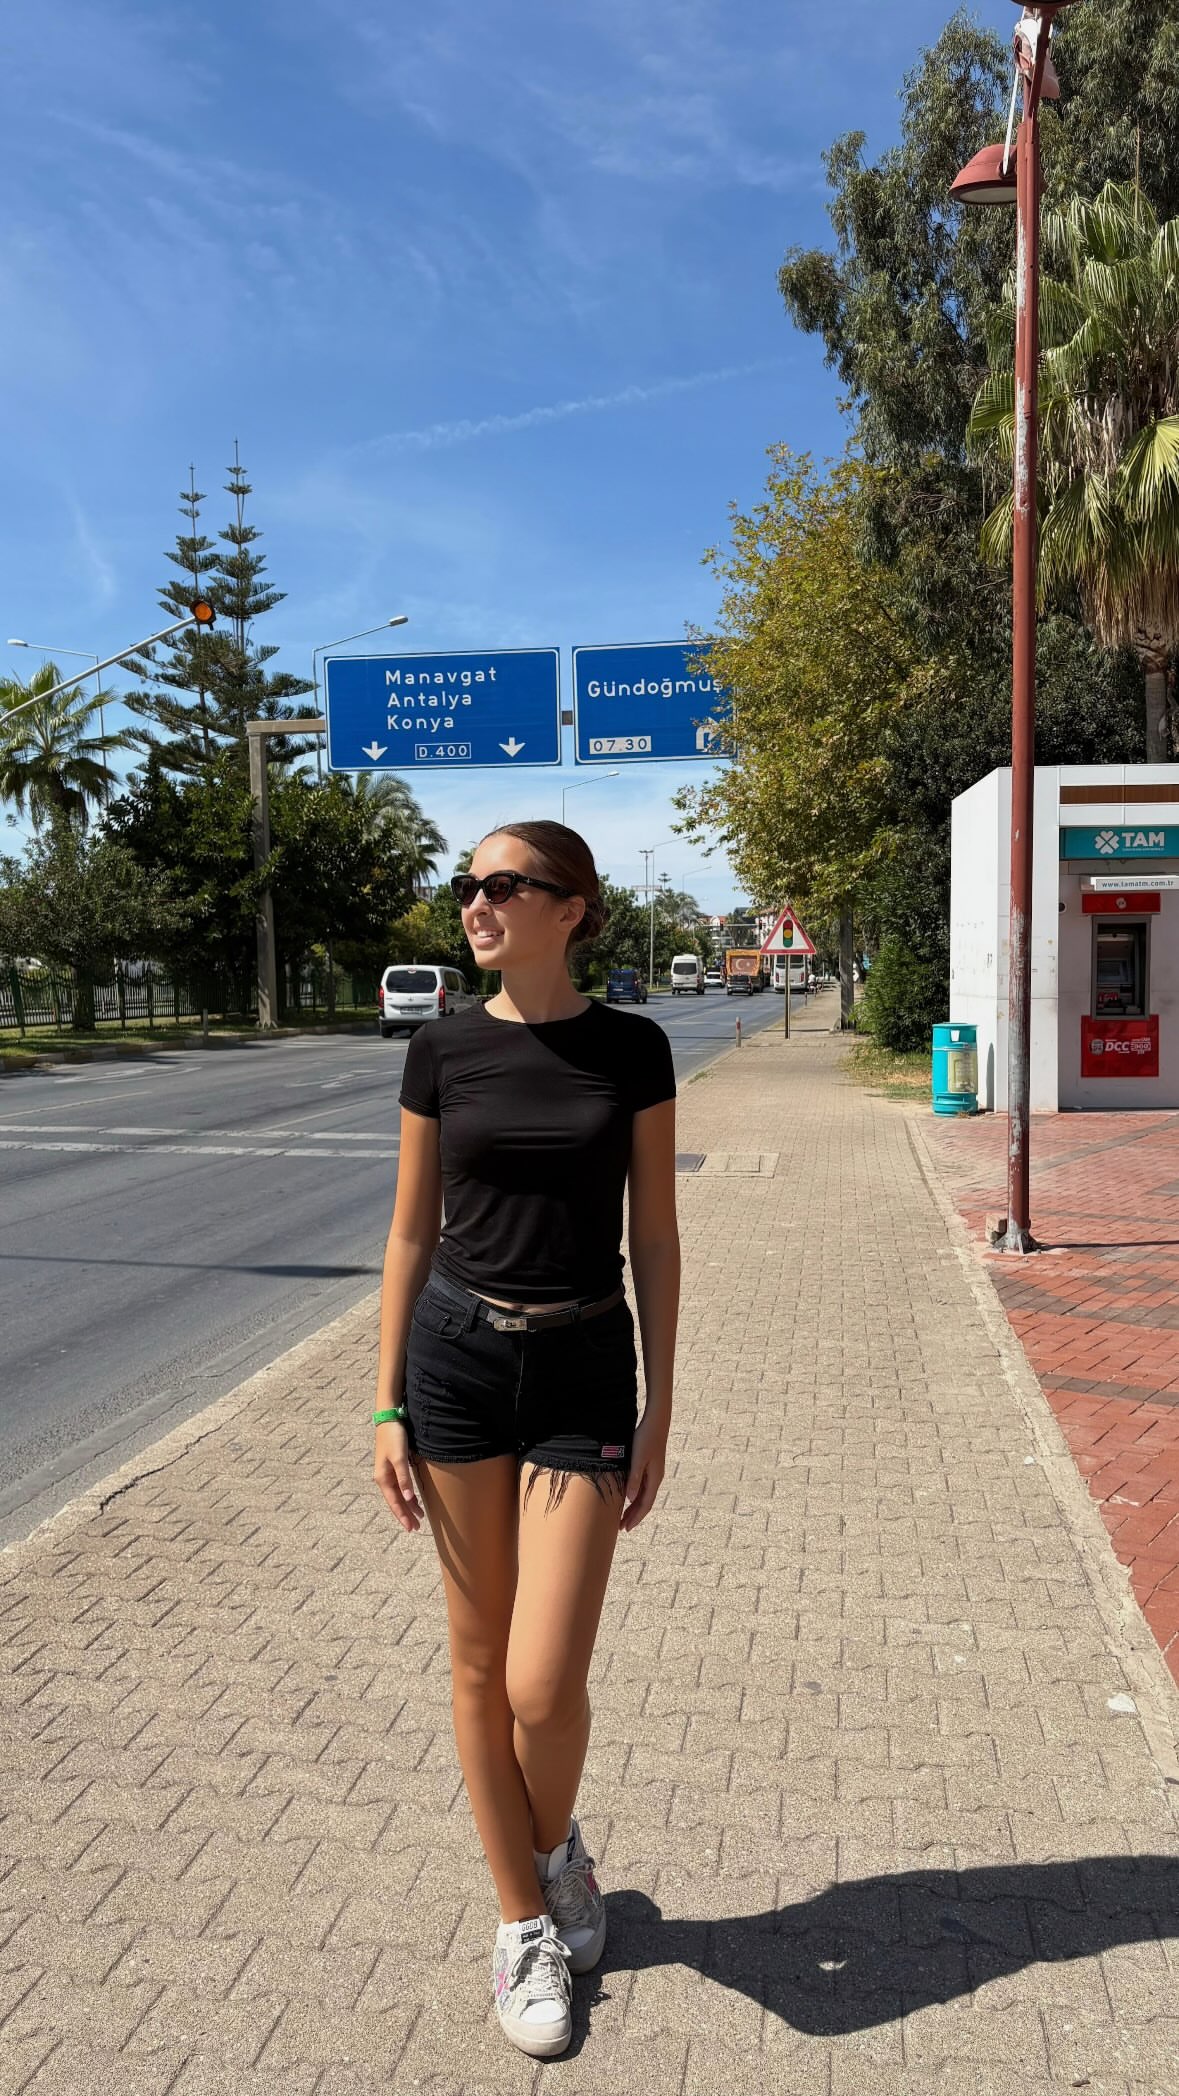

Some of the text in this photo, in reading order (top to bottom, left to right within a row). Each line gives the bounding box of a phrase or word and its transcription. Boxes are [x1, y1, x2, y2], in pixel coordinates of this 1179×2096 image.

[385, 667, 497, 686] Manavgat
[587, 678, 724, 698] Gündoğmuş
[387, 691, 472, 710] Antalya
[387, 714, 454, 733] Konya
[418, 745, 468, 758] D.400
[593, 738, 648, 752] 07.30
[1121, 831, 1165, 847] TAM
[1104, 1041, 1130, 1052] DCC
